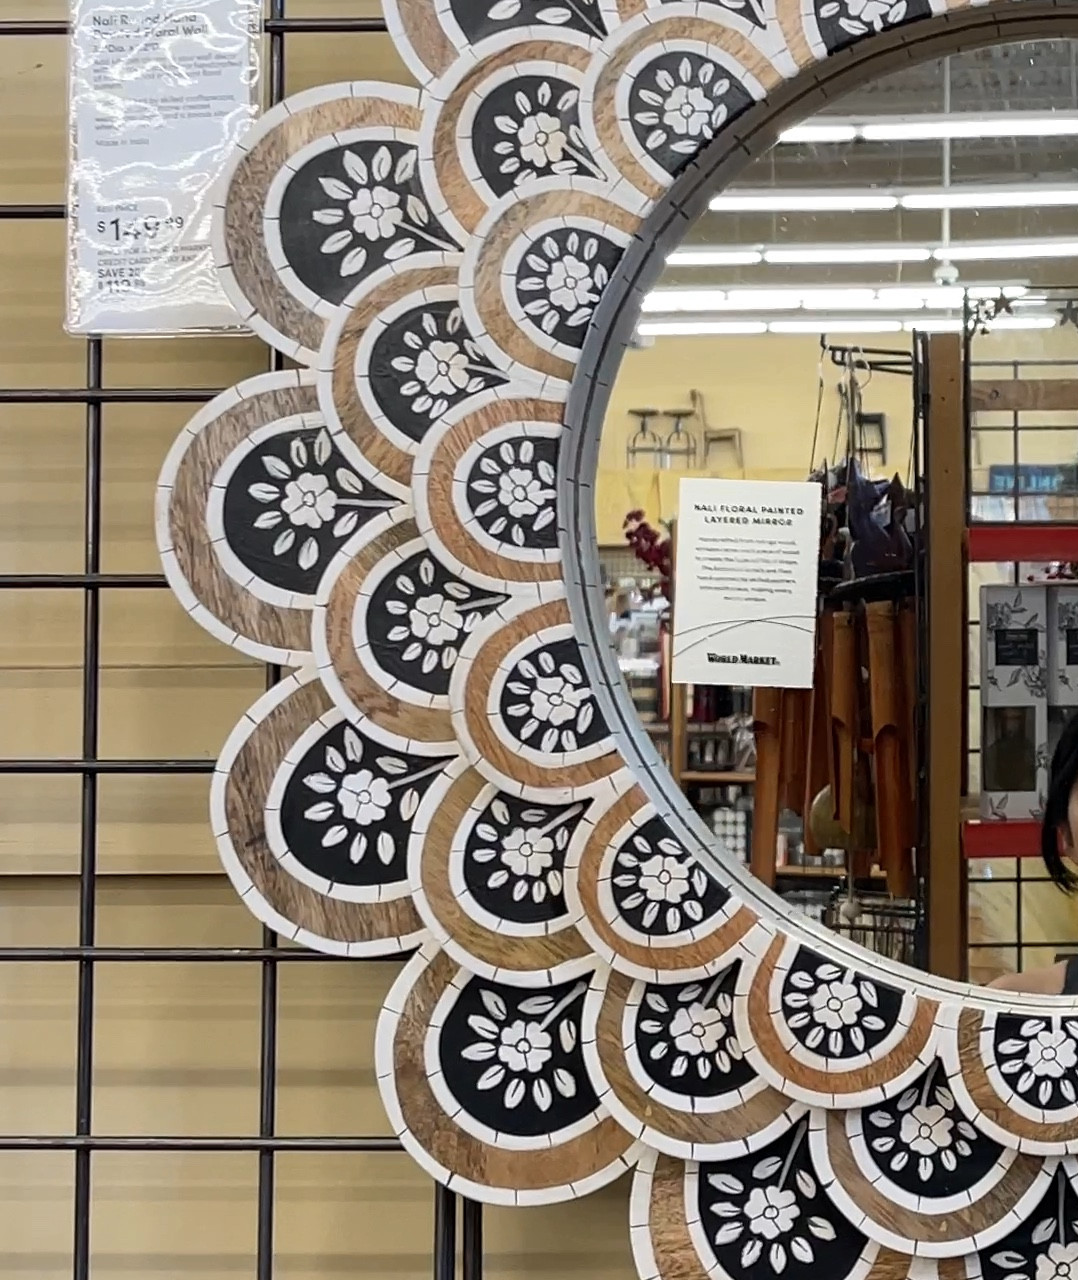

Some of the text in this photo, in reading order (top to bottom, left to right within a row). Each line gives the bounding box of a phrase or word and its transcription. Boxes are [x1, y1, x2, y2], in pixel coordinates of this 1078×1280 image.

[93, 15, 118, 26] Nali
[97, 268, 125, 279] SAVE
[694, 504, 804, 515] NALI FLORAL PAINTED
[704, 516, 793, 526] LAYERED MIRROR
[707, 652, 739, 664] WORLD
